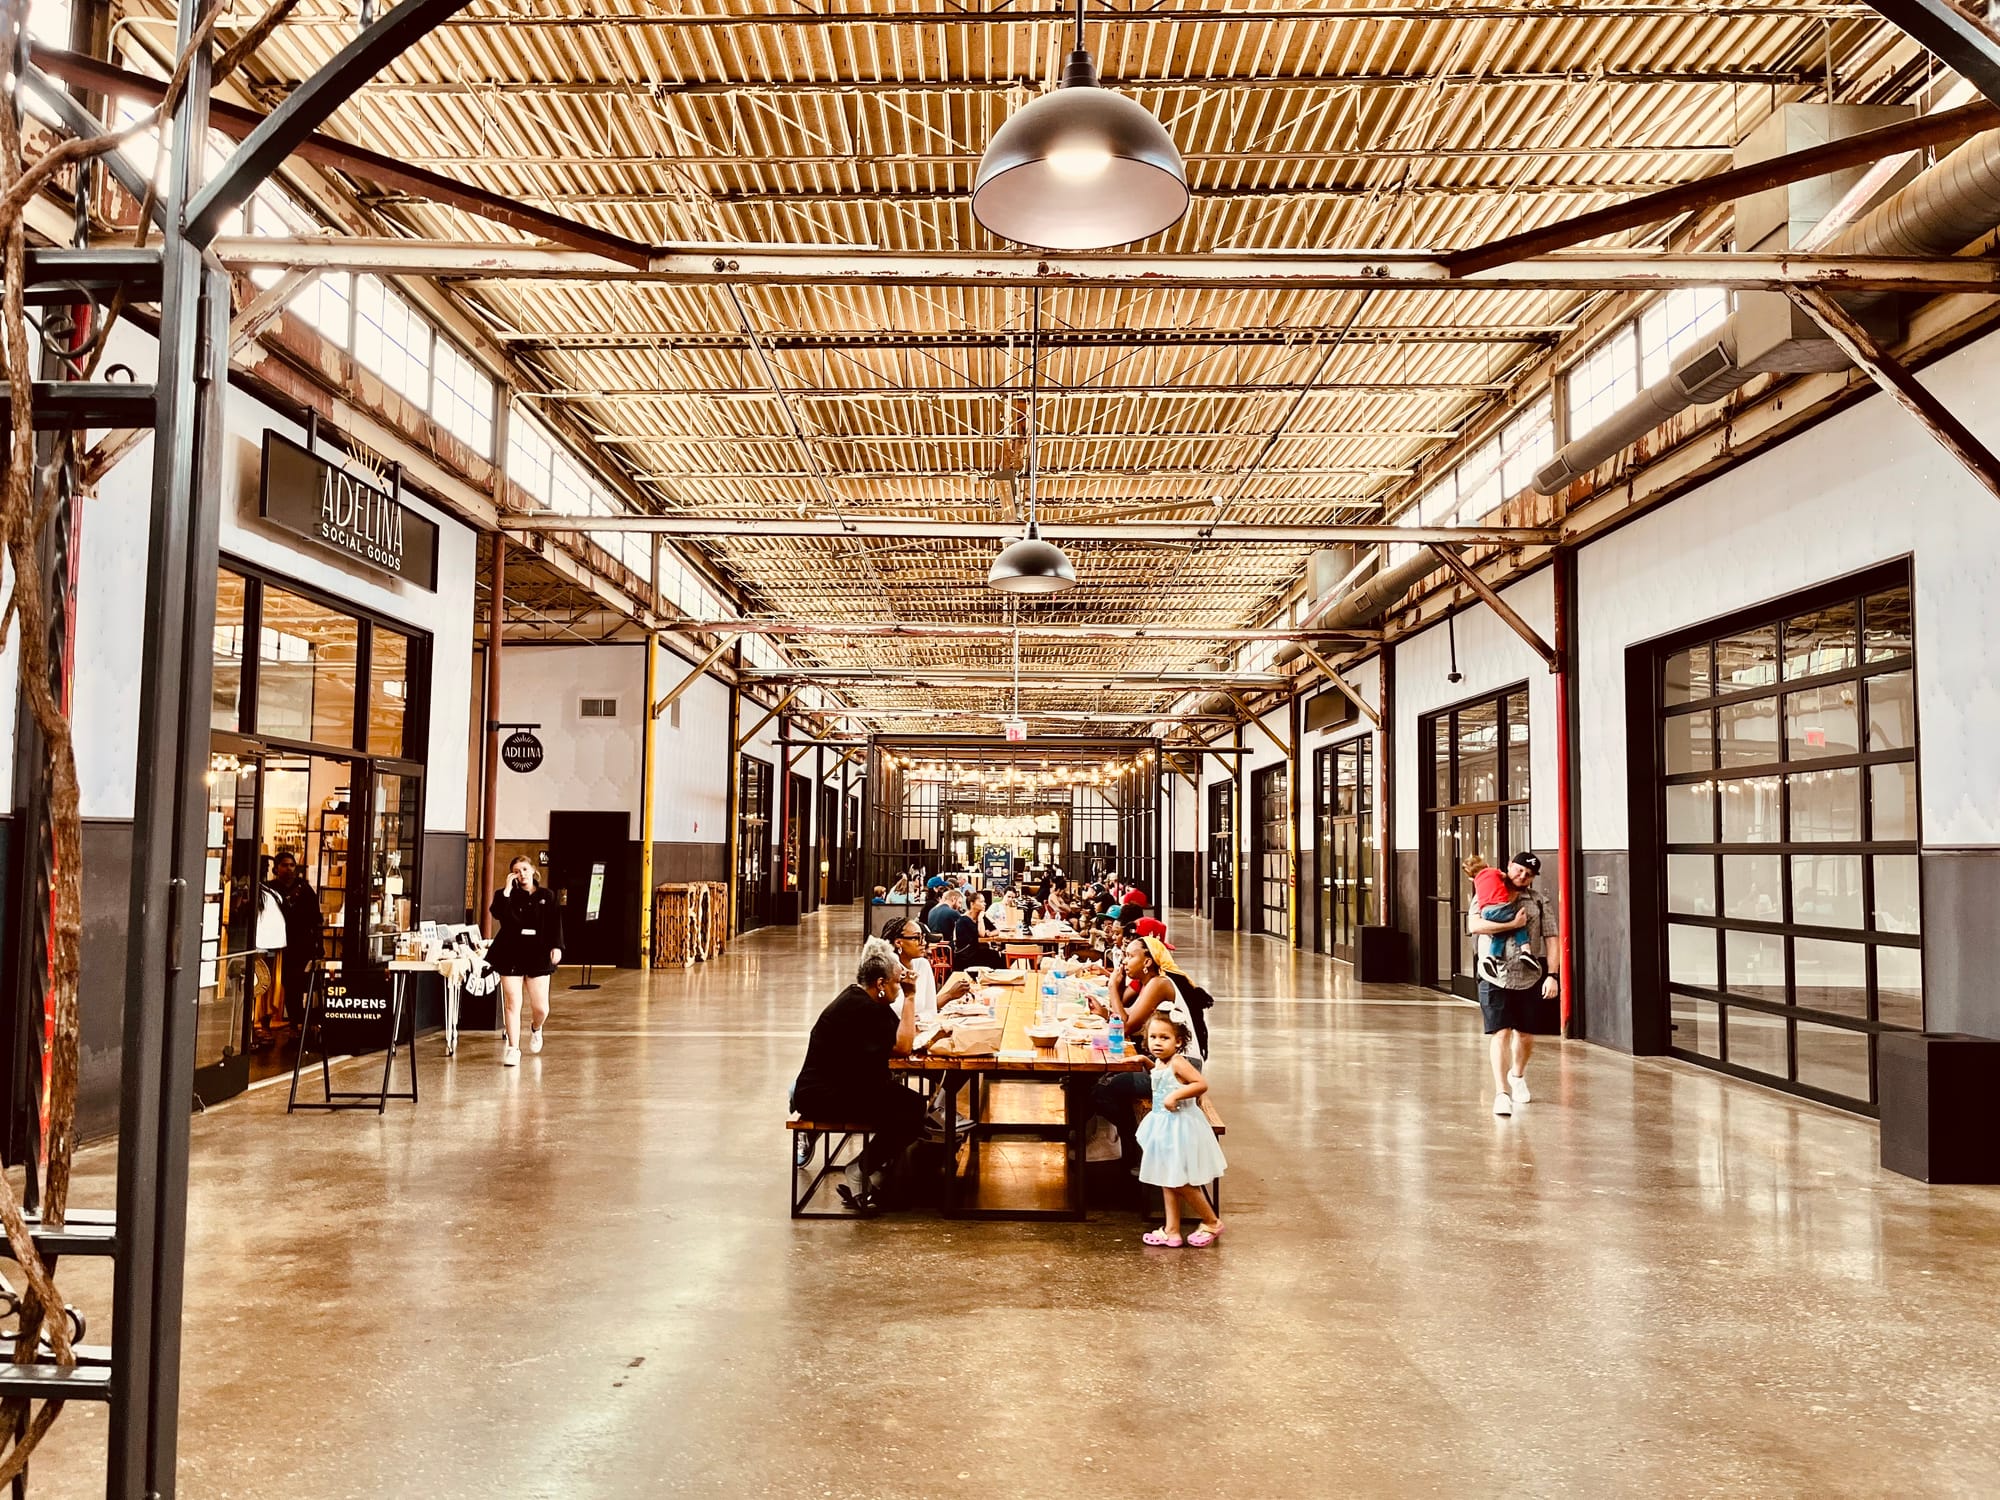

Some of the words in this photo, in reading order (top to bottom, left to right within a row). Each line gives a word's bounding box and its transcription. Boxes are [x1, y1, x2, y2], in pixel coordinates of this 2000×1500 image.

[322, 466, 403, 556] ADELINA
[322, 522, 363, 553] SOCIAL
[367, 544, 401, 571] GOODS
[326, 998, 387, 1009] HAPPENS
[327, 986, 347, 996] SIP
